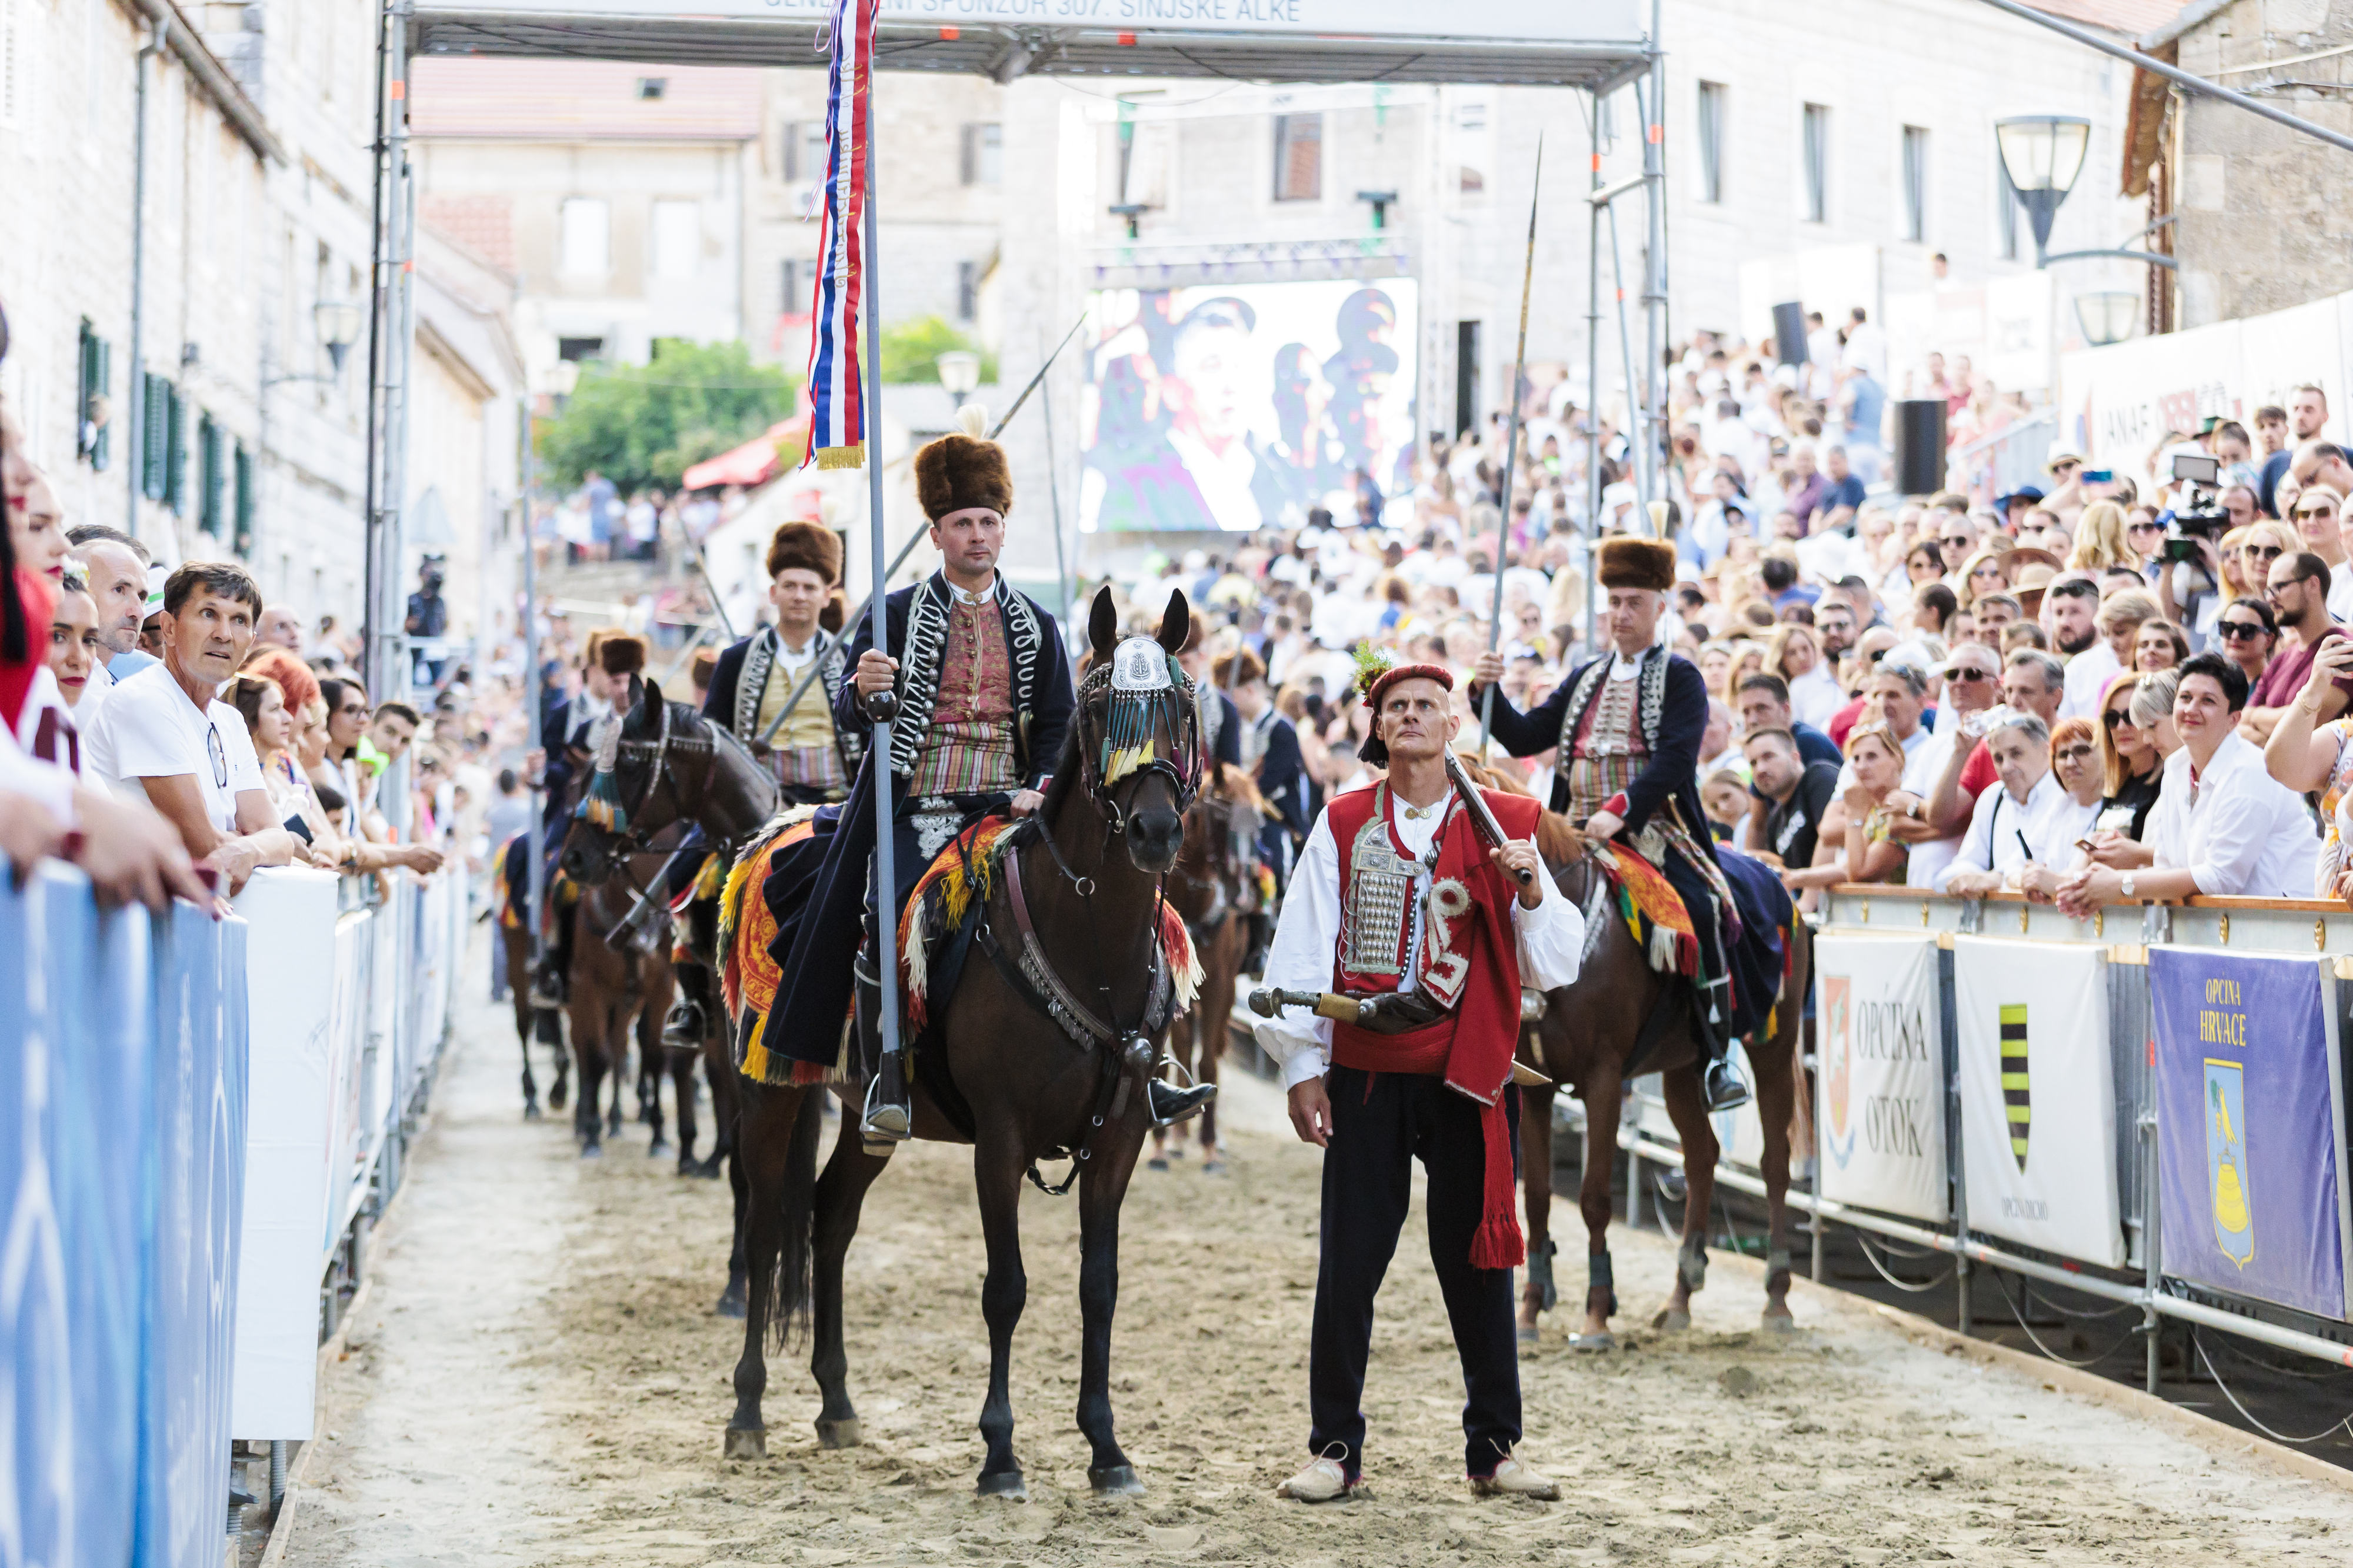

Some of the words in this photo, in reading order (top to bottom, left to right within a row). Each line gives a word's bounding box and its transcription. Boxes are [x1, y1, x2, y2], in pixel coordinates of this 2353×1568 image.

[1119, 0, 1227, 19] SINJSKE
[1235, 0, 1300, 22] ALKE
[2200, 1010, 2247, 1047] HRVACE
[1866, 1095, 1922, 1157] OTOK
